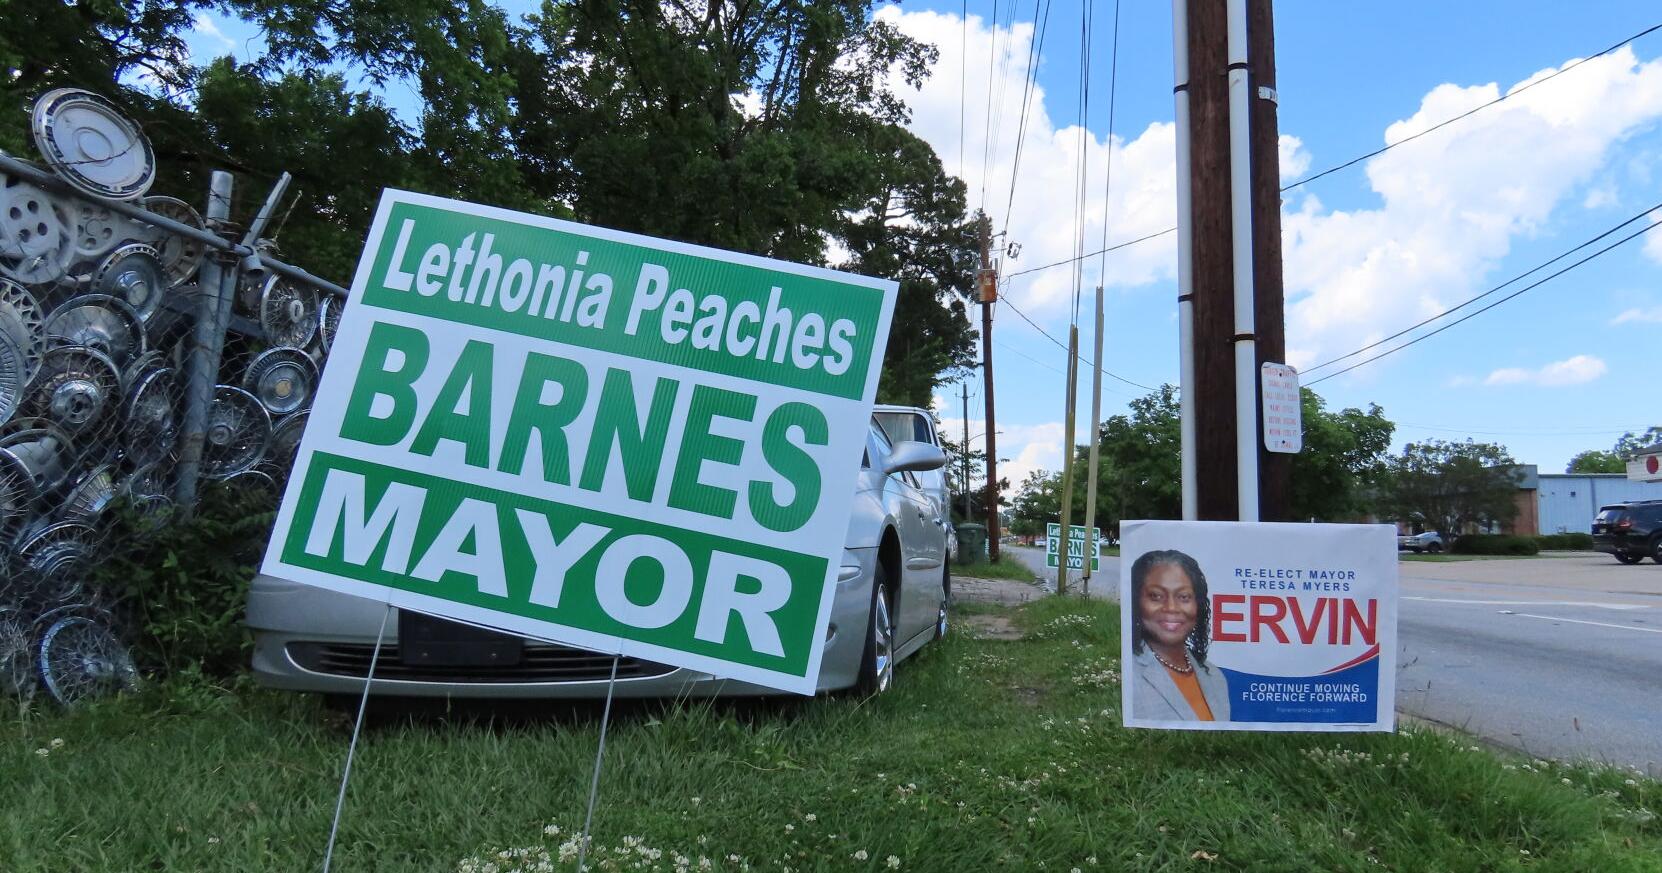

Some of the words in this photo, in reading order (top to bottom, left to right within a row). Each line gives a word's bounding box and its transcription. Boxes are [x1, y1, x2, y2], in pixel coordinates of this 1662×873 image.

[382, 218, 615, 330] Lethonia
[624, 262, 857, 376] Peaches
[338, 320, 830, 534] BARNES
[1050, 539, 1096, 556] BRNS
[303, 468, 794, 658] MAYOR
[1235, 568, 1302, 579] RE-ELECT
[1309, 570, 1356, 580] MAYOR
[1241, 580, 1296, 590] TERESA
[1303, 581, 1350, 592] MYERS
[1212, 594, 1377, 646] ERVIN
[1250, 682, 1310, 693] CONTINUE
[1314, 683, 1360, 693] MOVING
[1242, 691, 1306, 702] FLORENCE
[1310, 692, 1368, 703] FORWARD
